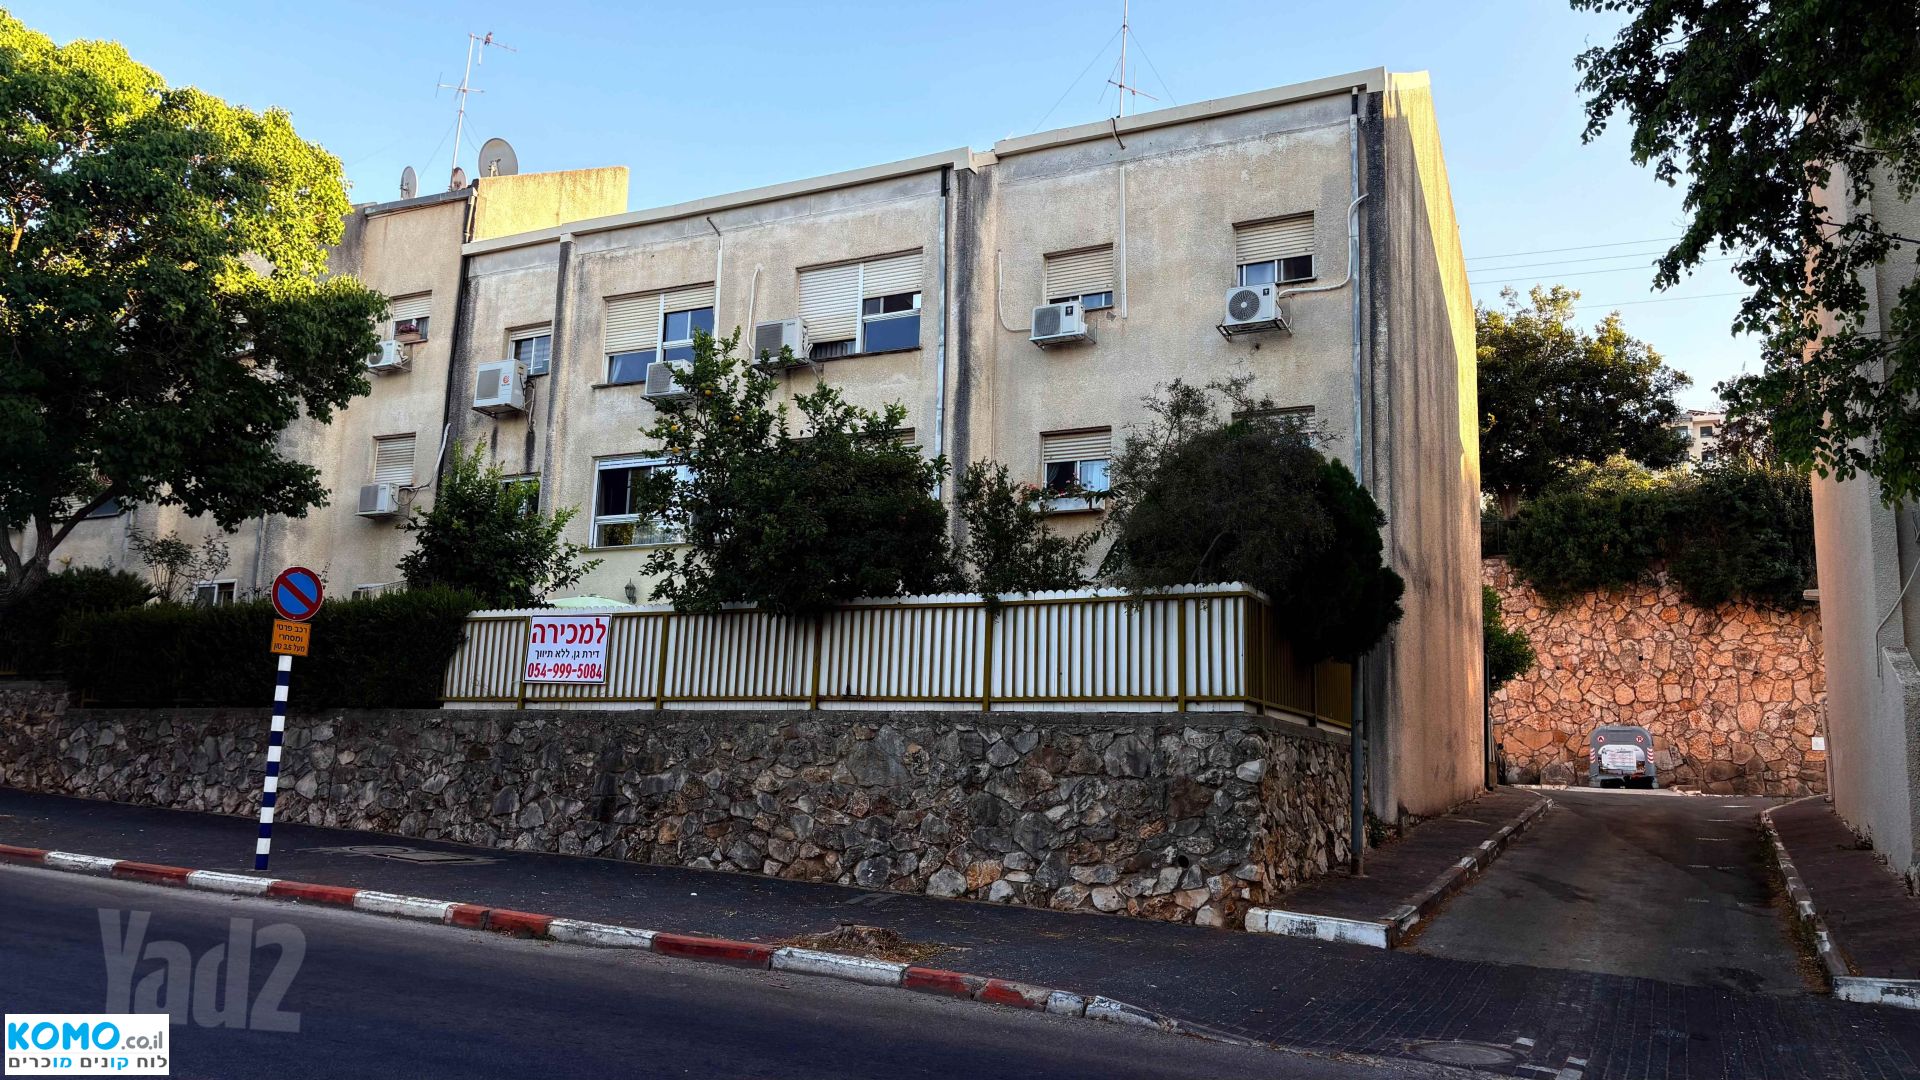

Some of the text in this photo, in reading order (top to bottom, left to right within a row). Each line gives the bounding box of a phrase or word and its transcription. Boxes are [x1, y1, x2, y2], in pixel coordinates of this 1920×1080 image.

[277, 623, 292, 631] פרטי
[532, 618, 606, 644] למכירה
[279, 634, 303, 642] ומסחרי
[536, 650, 553, 659] תיווך
[555, 648, 570, 658] ללא
[582, 650, 599, 658] דירת
[528, 663, 602, 679] 054-999-5084
